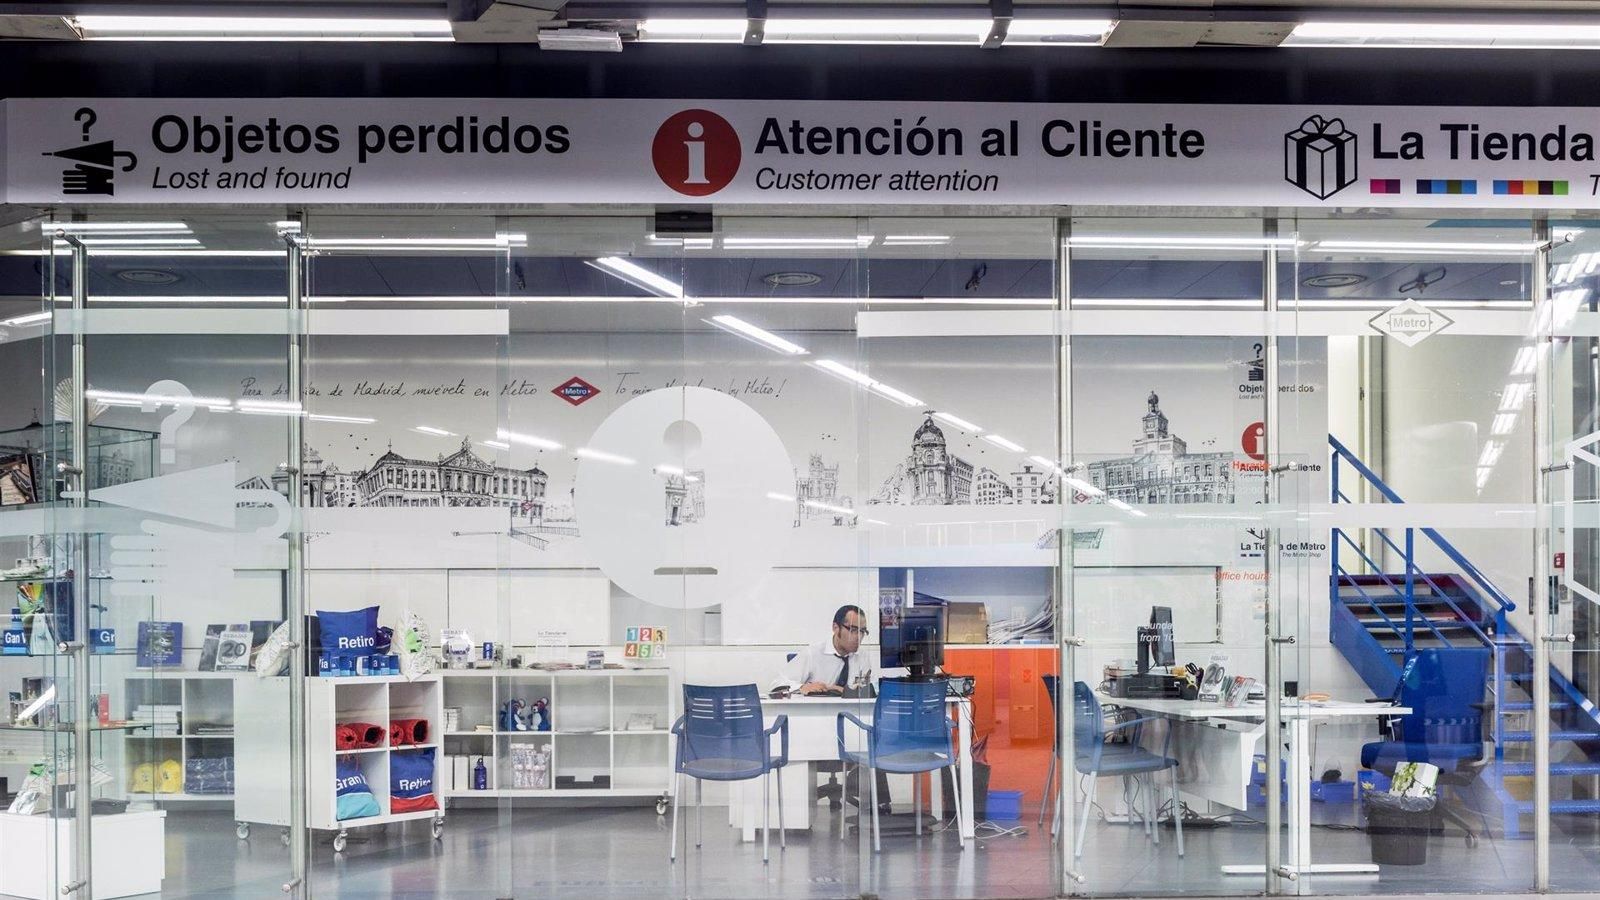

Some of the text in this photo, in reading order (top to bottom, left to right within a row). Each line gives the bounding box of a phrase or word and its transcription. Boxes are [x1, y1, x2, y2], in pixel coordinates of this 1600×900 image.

[152, 114, 571, 164] Objetos perdidos
[754, 116, 1206, 159] Atención al Cliente
[1373, 123, 1595, 162] La Tienda
[152, 167, 352, 189] Lost and found
[755, 167, 999, 192] Customer attention
[1393, 318, 1427, 328] Metro
[328, 383, 343, 396] de
[474, 389, 490, 397] en
[501, 379, 538, 396] Metro
[616, 372, 640, 394] To
[1239, 384, 1315, 394] Objet erddos
[1297, 462, 1321, 472] liente
[339, 635, 375, 649] Retiro
[1140, 633, 1161, 642] from
[222, 643, 247, 657] 20
[1205, 665, 1225, 684] 20
